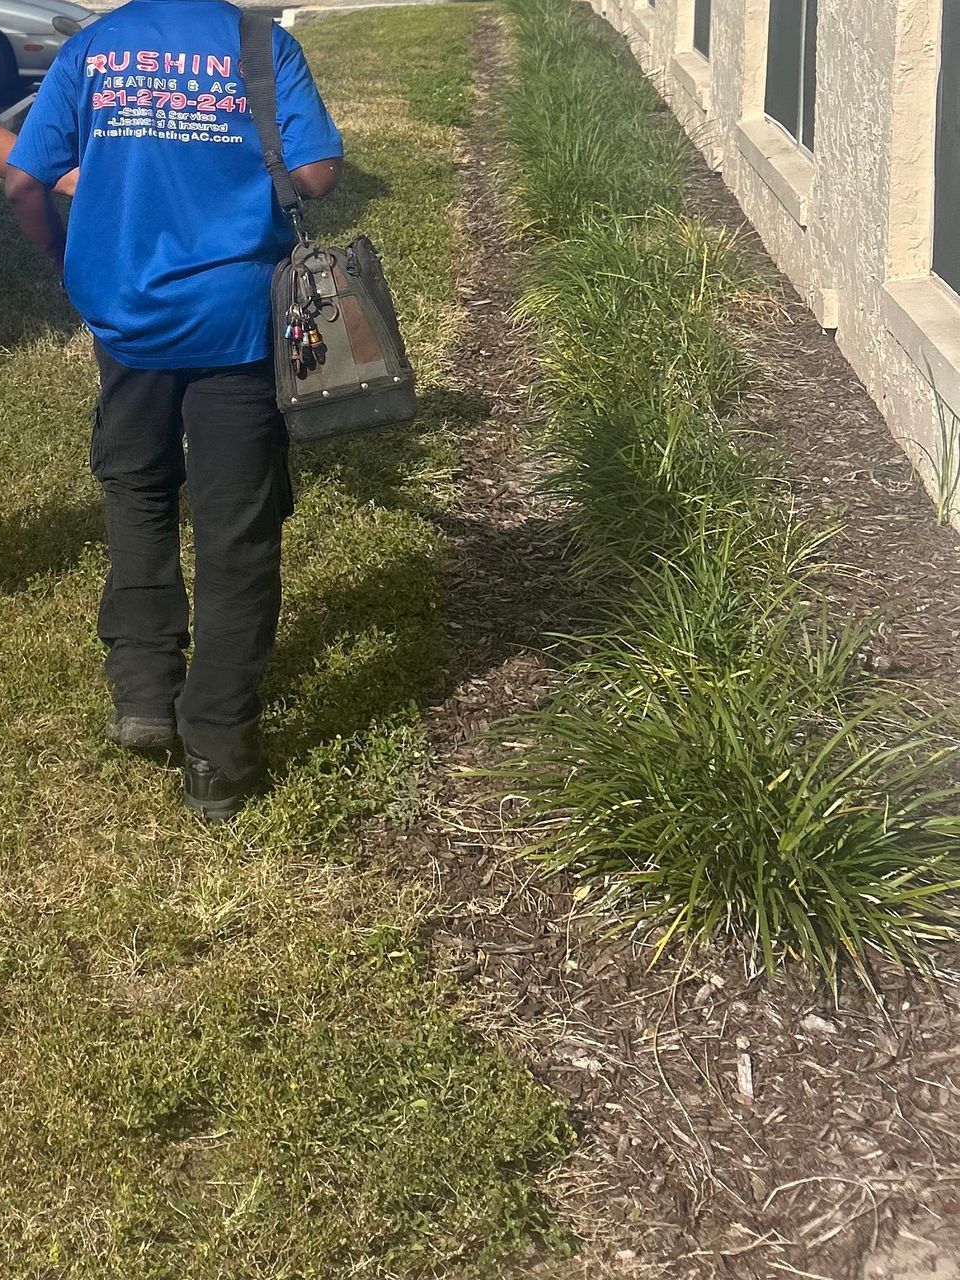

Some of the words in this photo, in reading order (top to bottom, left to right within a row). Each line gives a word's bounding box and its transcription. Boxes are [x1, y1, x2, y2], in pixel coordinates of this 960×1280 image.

[86, 51, 246, 78] RUSHIN
[103, 75, 177, 91] HEATING
[187, 79, 199, 92] &
[210, 81, 237, 94] AC
[92, 89, 252, 114] 321-279-241
[155, 109, 166, 119] &
[168, 110, 217, 122] Service
[167, 120, 177, 130] &
[178, 120, 228, 133] Insured
